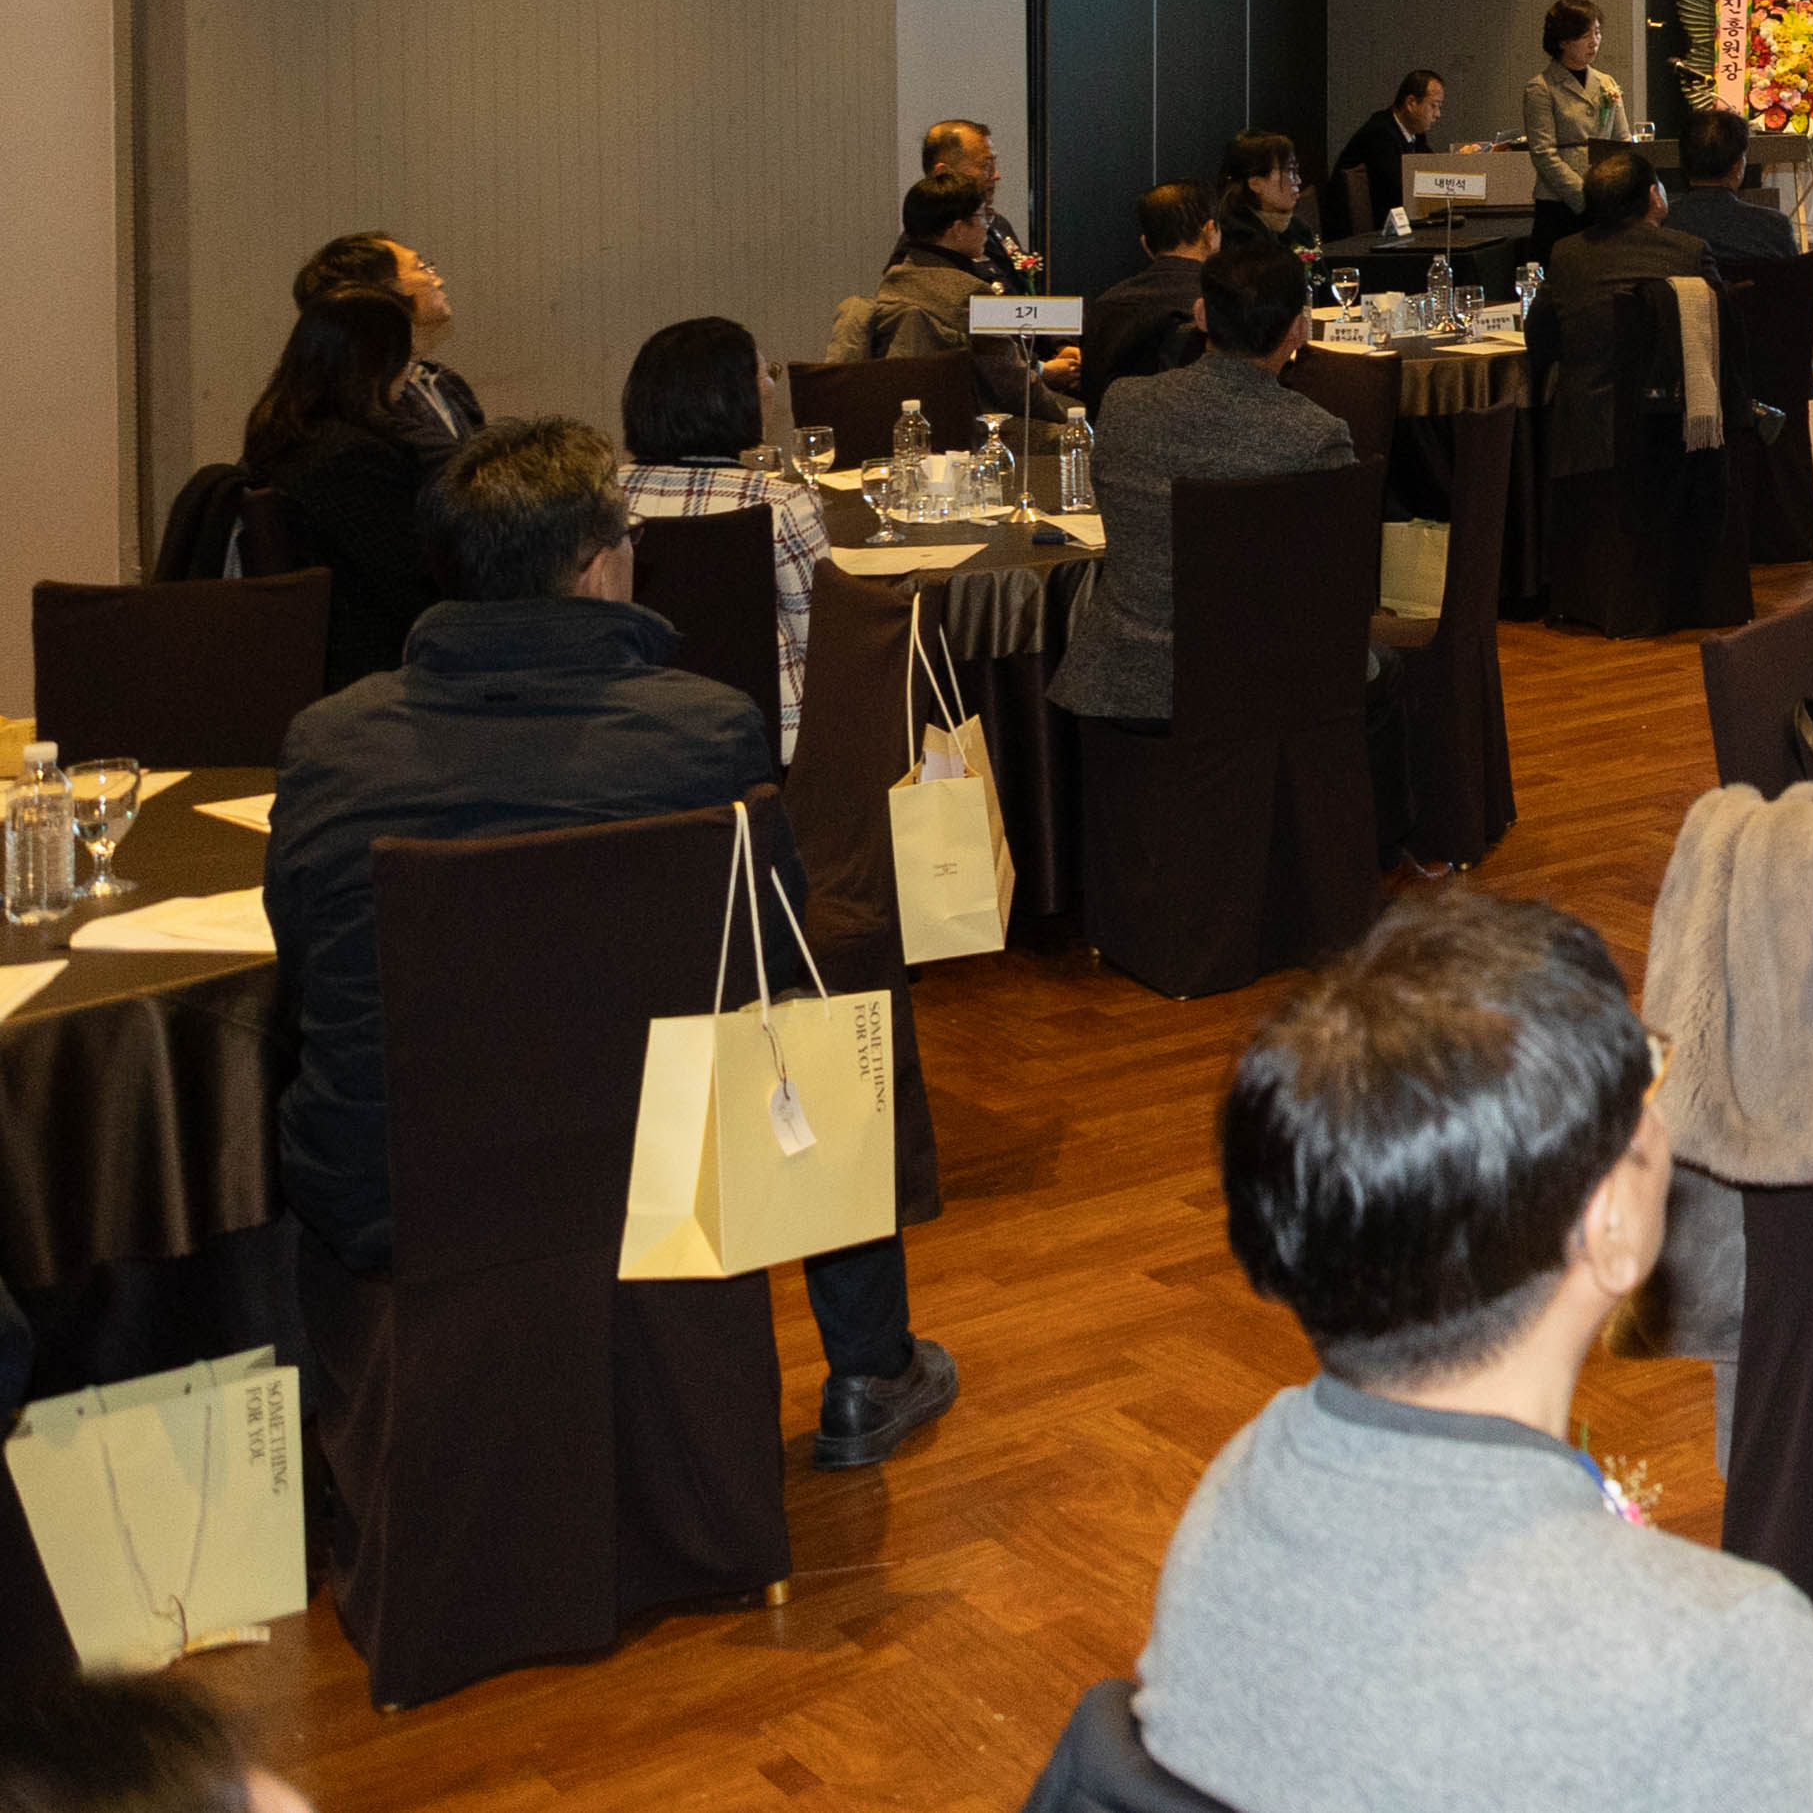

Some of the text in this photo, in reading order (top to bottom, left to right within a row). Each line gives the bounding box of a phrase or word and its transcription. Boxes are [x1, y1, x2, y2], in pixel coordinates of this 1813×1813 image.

[1434, 178, 1467, 191] 내빈석
[1015, 306, 1038, 319] 1기
[854, 1004, 871, 1082] FOR YOU
[869, 1001, 886, 1112] SOMETHING
[246, 1386, 263, 1425] FOR
[266, 1380, 288, 1495] SOMETHING
